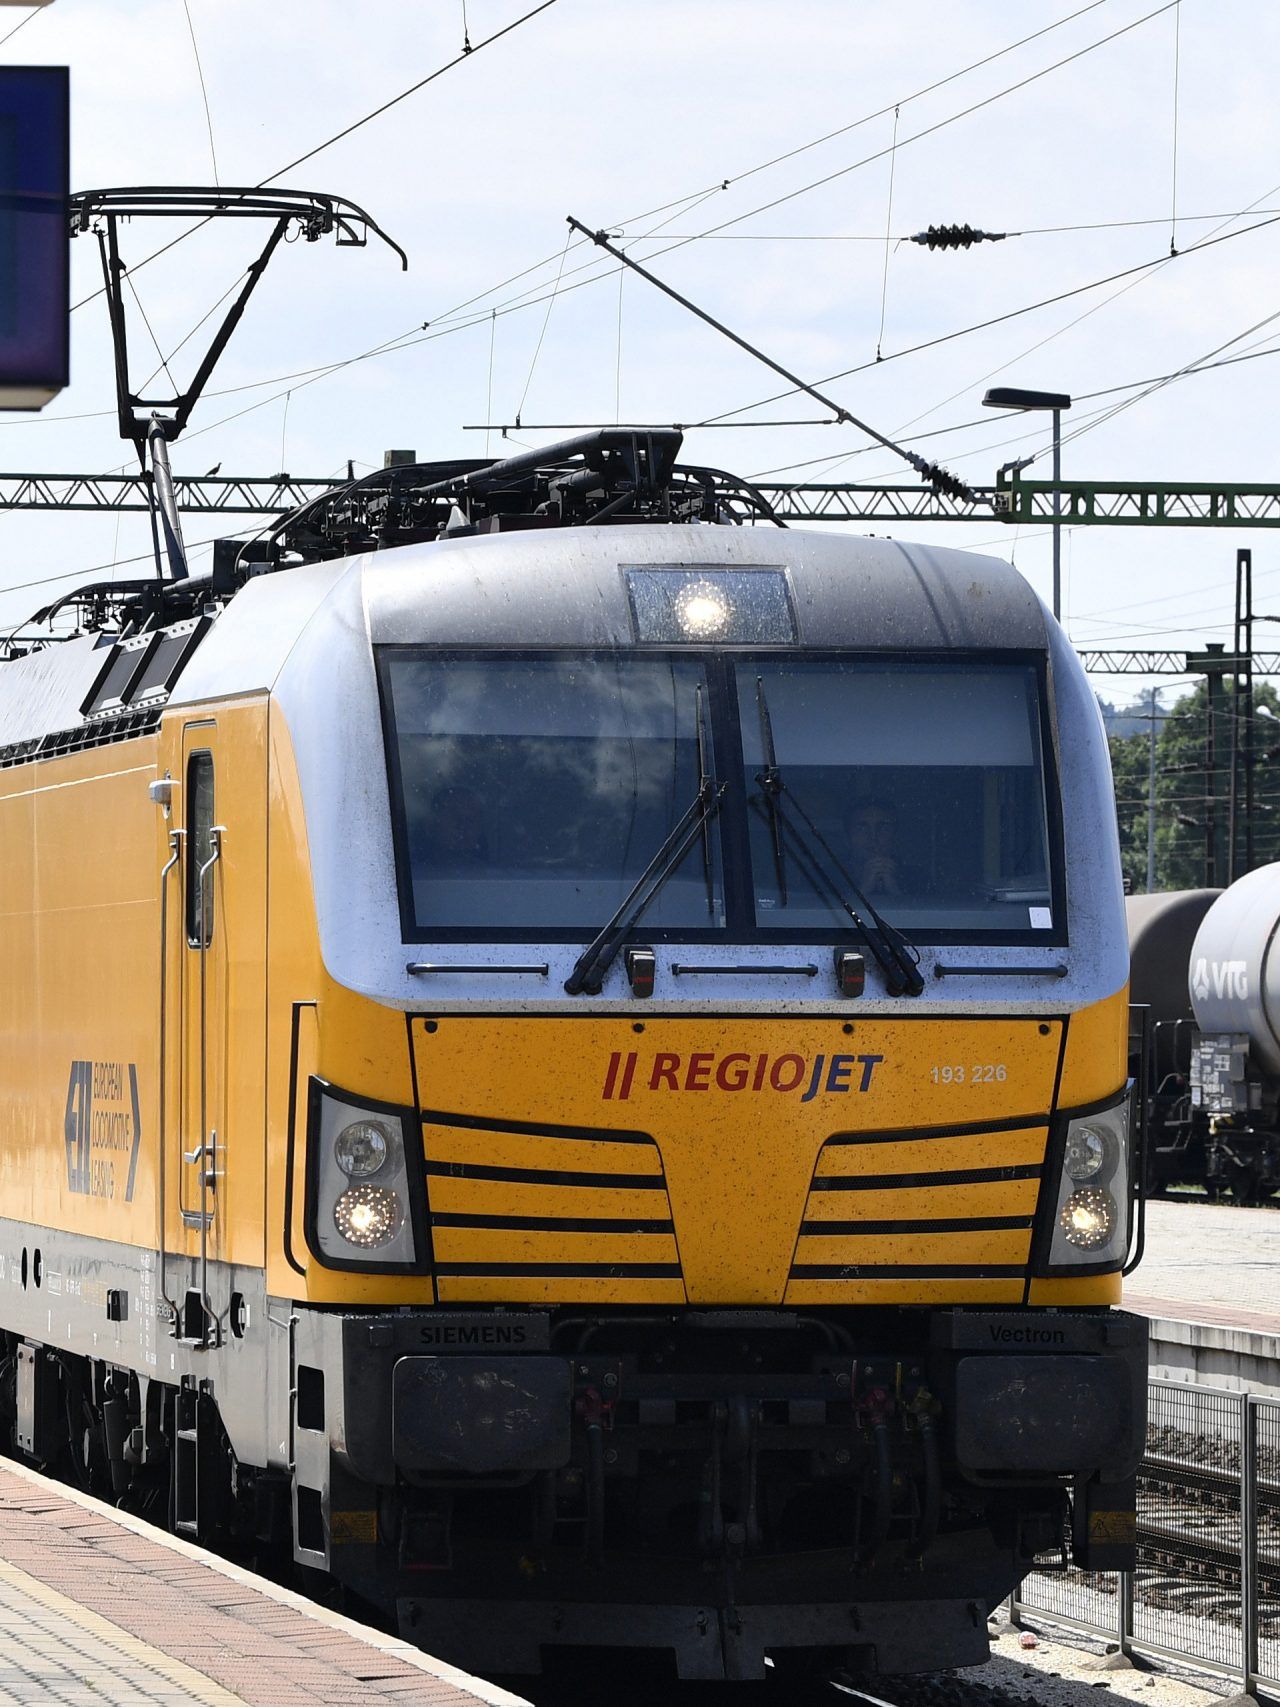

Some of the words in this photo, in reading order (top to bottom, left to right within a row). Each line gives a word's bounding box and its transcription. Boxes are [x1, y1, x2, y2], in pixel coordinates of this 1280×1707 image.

[1211, 960, 1249, 1001] VTG
[649, 1052, 884, 1103] REGIOJET
[930, 1066, 965, 1083] 193
[971, 1064, 1008, 1082] 226
[92, 1110, 130, 1152] LOCOMOTIVE
[420, 1325, 526, 1344] SIEMENS
[989, 1324, 1065, 1343] Vectron
